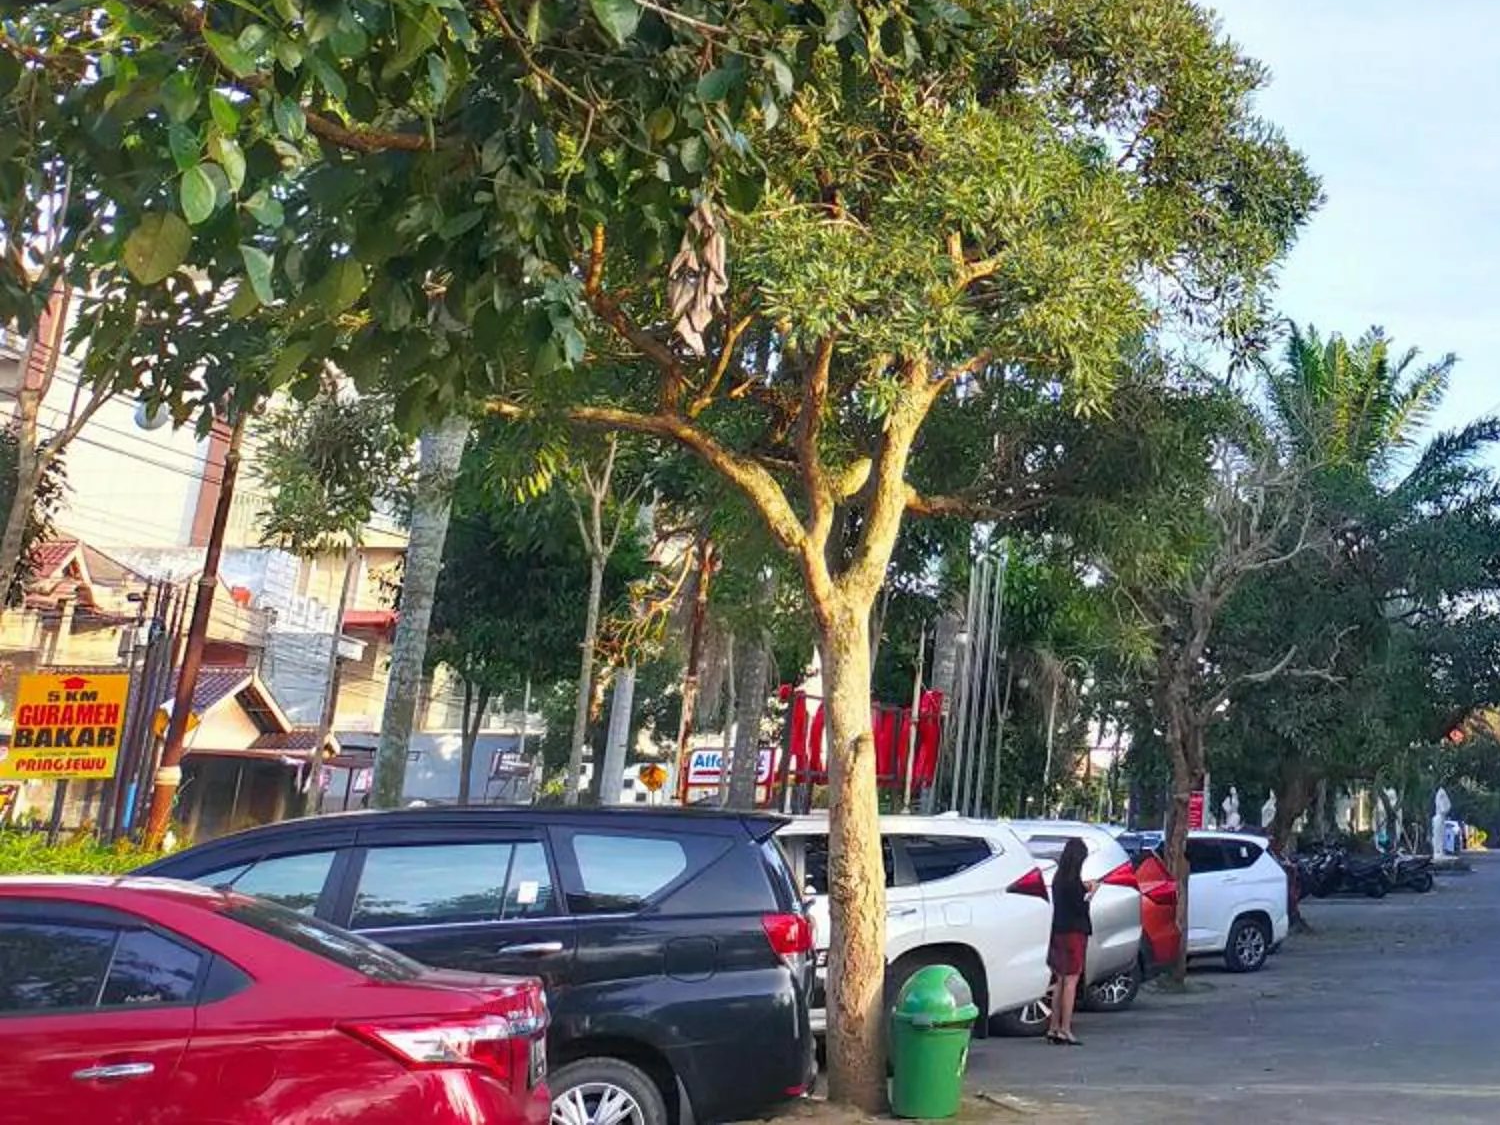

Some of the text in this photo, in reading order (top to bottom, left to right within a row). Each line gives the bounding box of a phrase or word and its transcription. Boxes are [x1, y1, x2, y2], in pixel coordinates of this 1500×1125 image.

[65, 690, 98, 702] KM
[18, 703, 119, 725] GURAMEH
[14, 727, 116, 747] BAKAR
